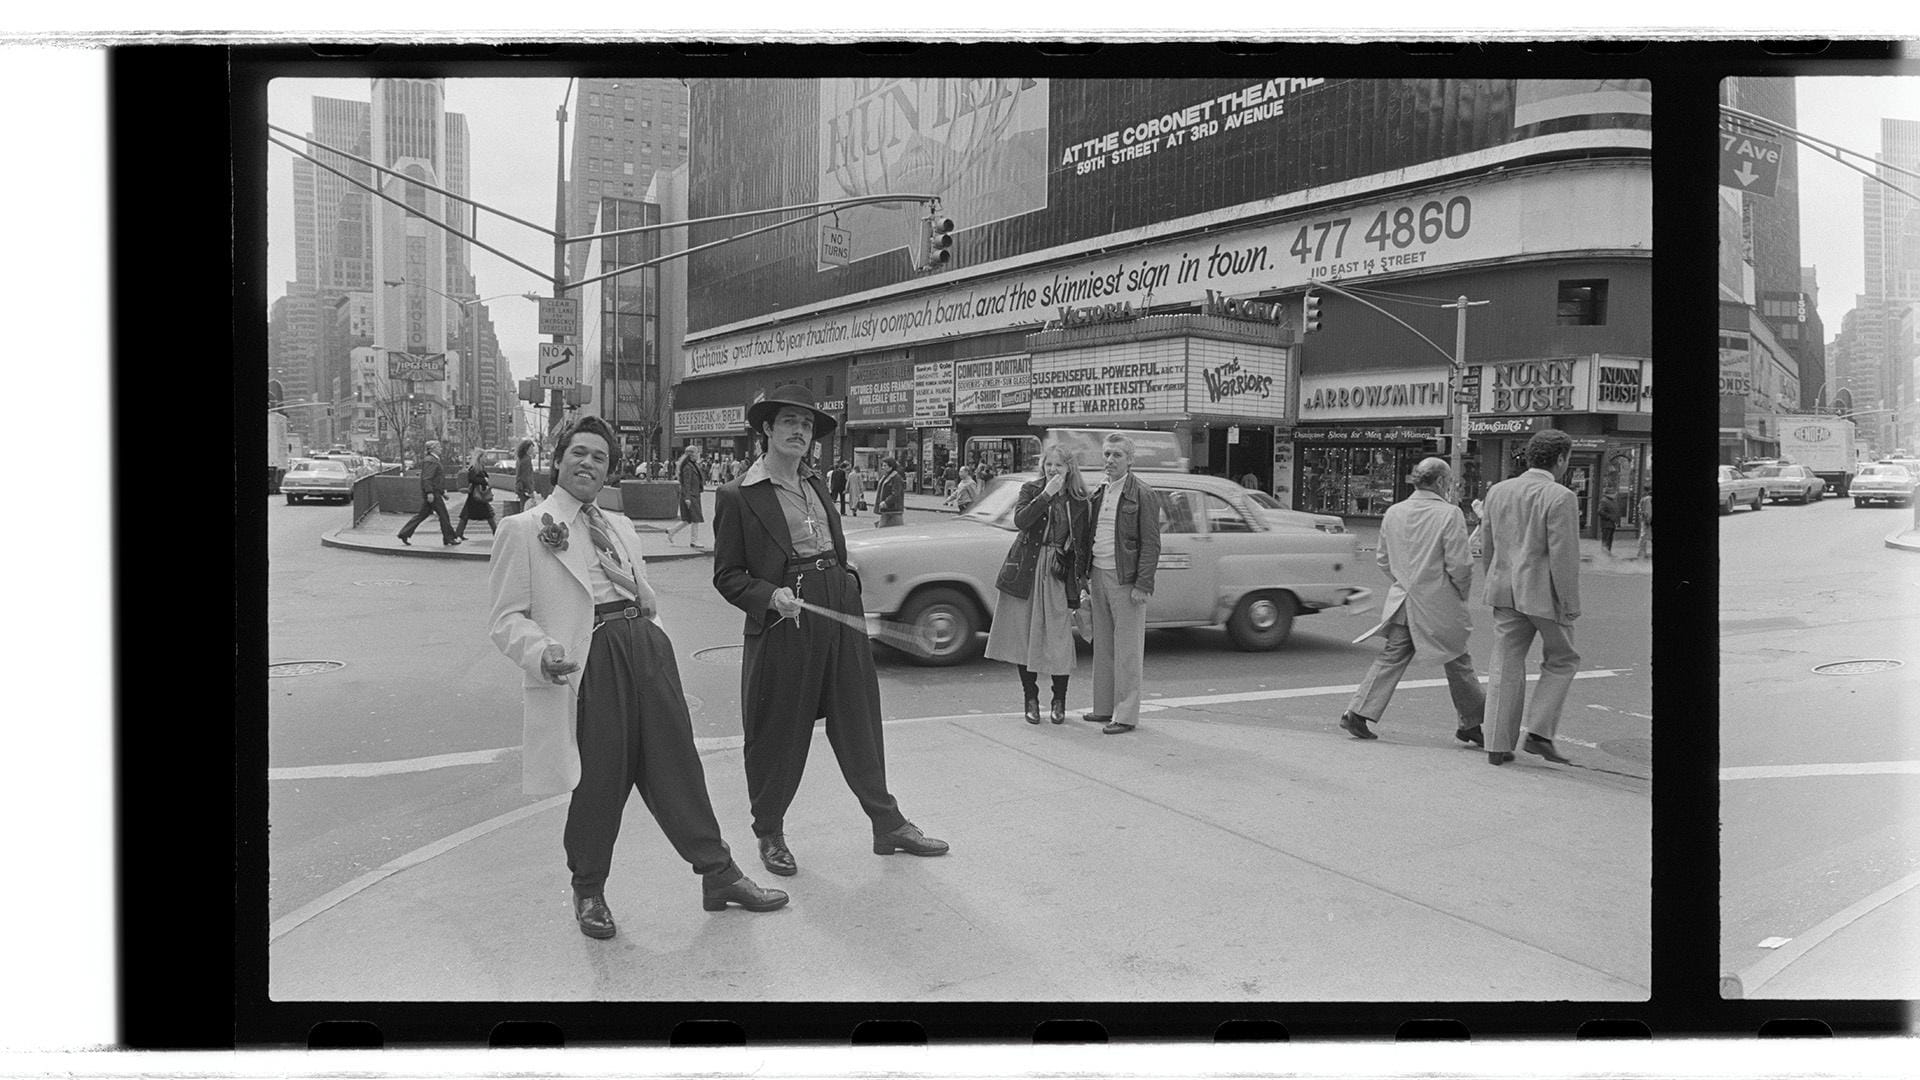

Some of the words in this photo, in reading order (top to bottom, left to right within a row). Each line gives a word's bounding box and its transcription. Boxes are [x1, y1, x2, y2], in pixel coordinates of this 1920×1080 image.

[1062, 144, 1083, 165] AT
[1084, 132, 1119, 158] THE
[1122, 100, 1214, 145] CORONET
[1076, 152, 1105, 176] 59TH
[1112, 138, 1160, 165] STREET
[1166, 130, 1185, 149] AT
[1190, 120, 1218, 141] 3RD
[1224, 100, 1284, 131] AVENUE
[1720, 133, 1736, 151] 7
[1736, 140, 1778, 163] Ave
[831, 232, 843, 245] NO
[1290, 217, 1352, 264] 477
[1364, 195, 1471, 251] 4860
[824, 244, 848, 259] TURNS
[1311, 266, 1327, 278] 110
[1331, 262, 1359, 275] EAST
[1363, 259, 1375, 270] 14
[1380, 251, 1427, 267] STREET
[732, 336, 753, 366] great
[786, 330, 806, 357] year
[852, 315, 878, 341] lusty
[880, 300, 931, 337] oompah
[976, 285, 1009, 317] and
[1009, 282, 1036, 312] the
[1041, 264, 1124, 307] skinniest
[1127, 260, 1171, 298] sign
[1177, 252, 1200, 284] in
[1057, 300, 1135, 326] VICTORIA
[542, 346, 559, 357] NO
[957, 361, 993, 379] COMPUTER
[1032, 366, 1098, 385] SUSPENSEFUL
[1101, 362, 1159, 379] POWERFUL
[1220, 356, 1240, 376] THE
[1492, 360, 1576, 387] NUNN
[1601, 366, 1639, 384] NUNN
[542, 375, 573, 386] TURN
[873, 382, 890, 393] GLASS
[1032, 382, 1091, 400] MESMERIZING
[1094, 379, 1151, 396] INTENSITY
[974, 389, 1001, 404] T-SHIRT
[1491, 386, 1574, 413] BUSH
[1600, 385, 1638, 403] BUSH
[1053, 400, 1076, 414] THE
[1083, 397, 1145, 413] WARRIORS
[678, 410, 715, 425] BEEFSTEAK
[1327, 431, 1347, 439] Shoes
[1350, 431, 1362, 439] for
[1365, 431, 1381, 440] Men
[1384, 431, 1398, 440] and
